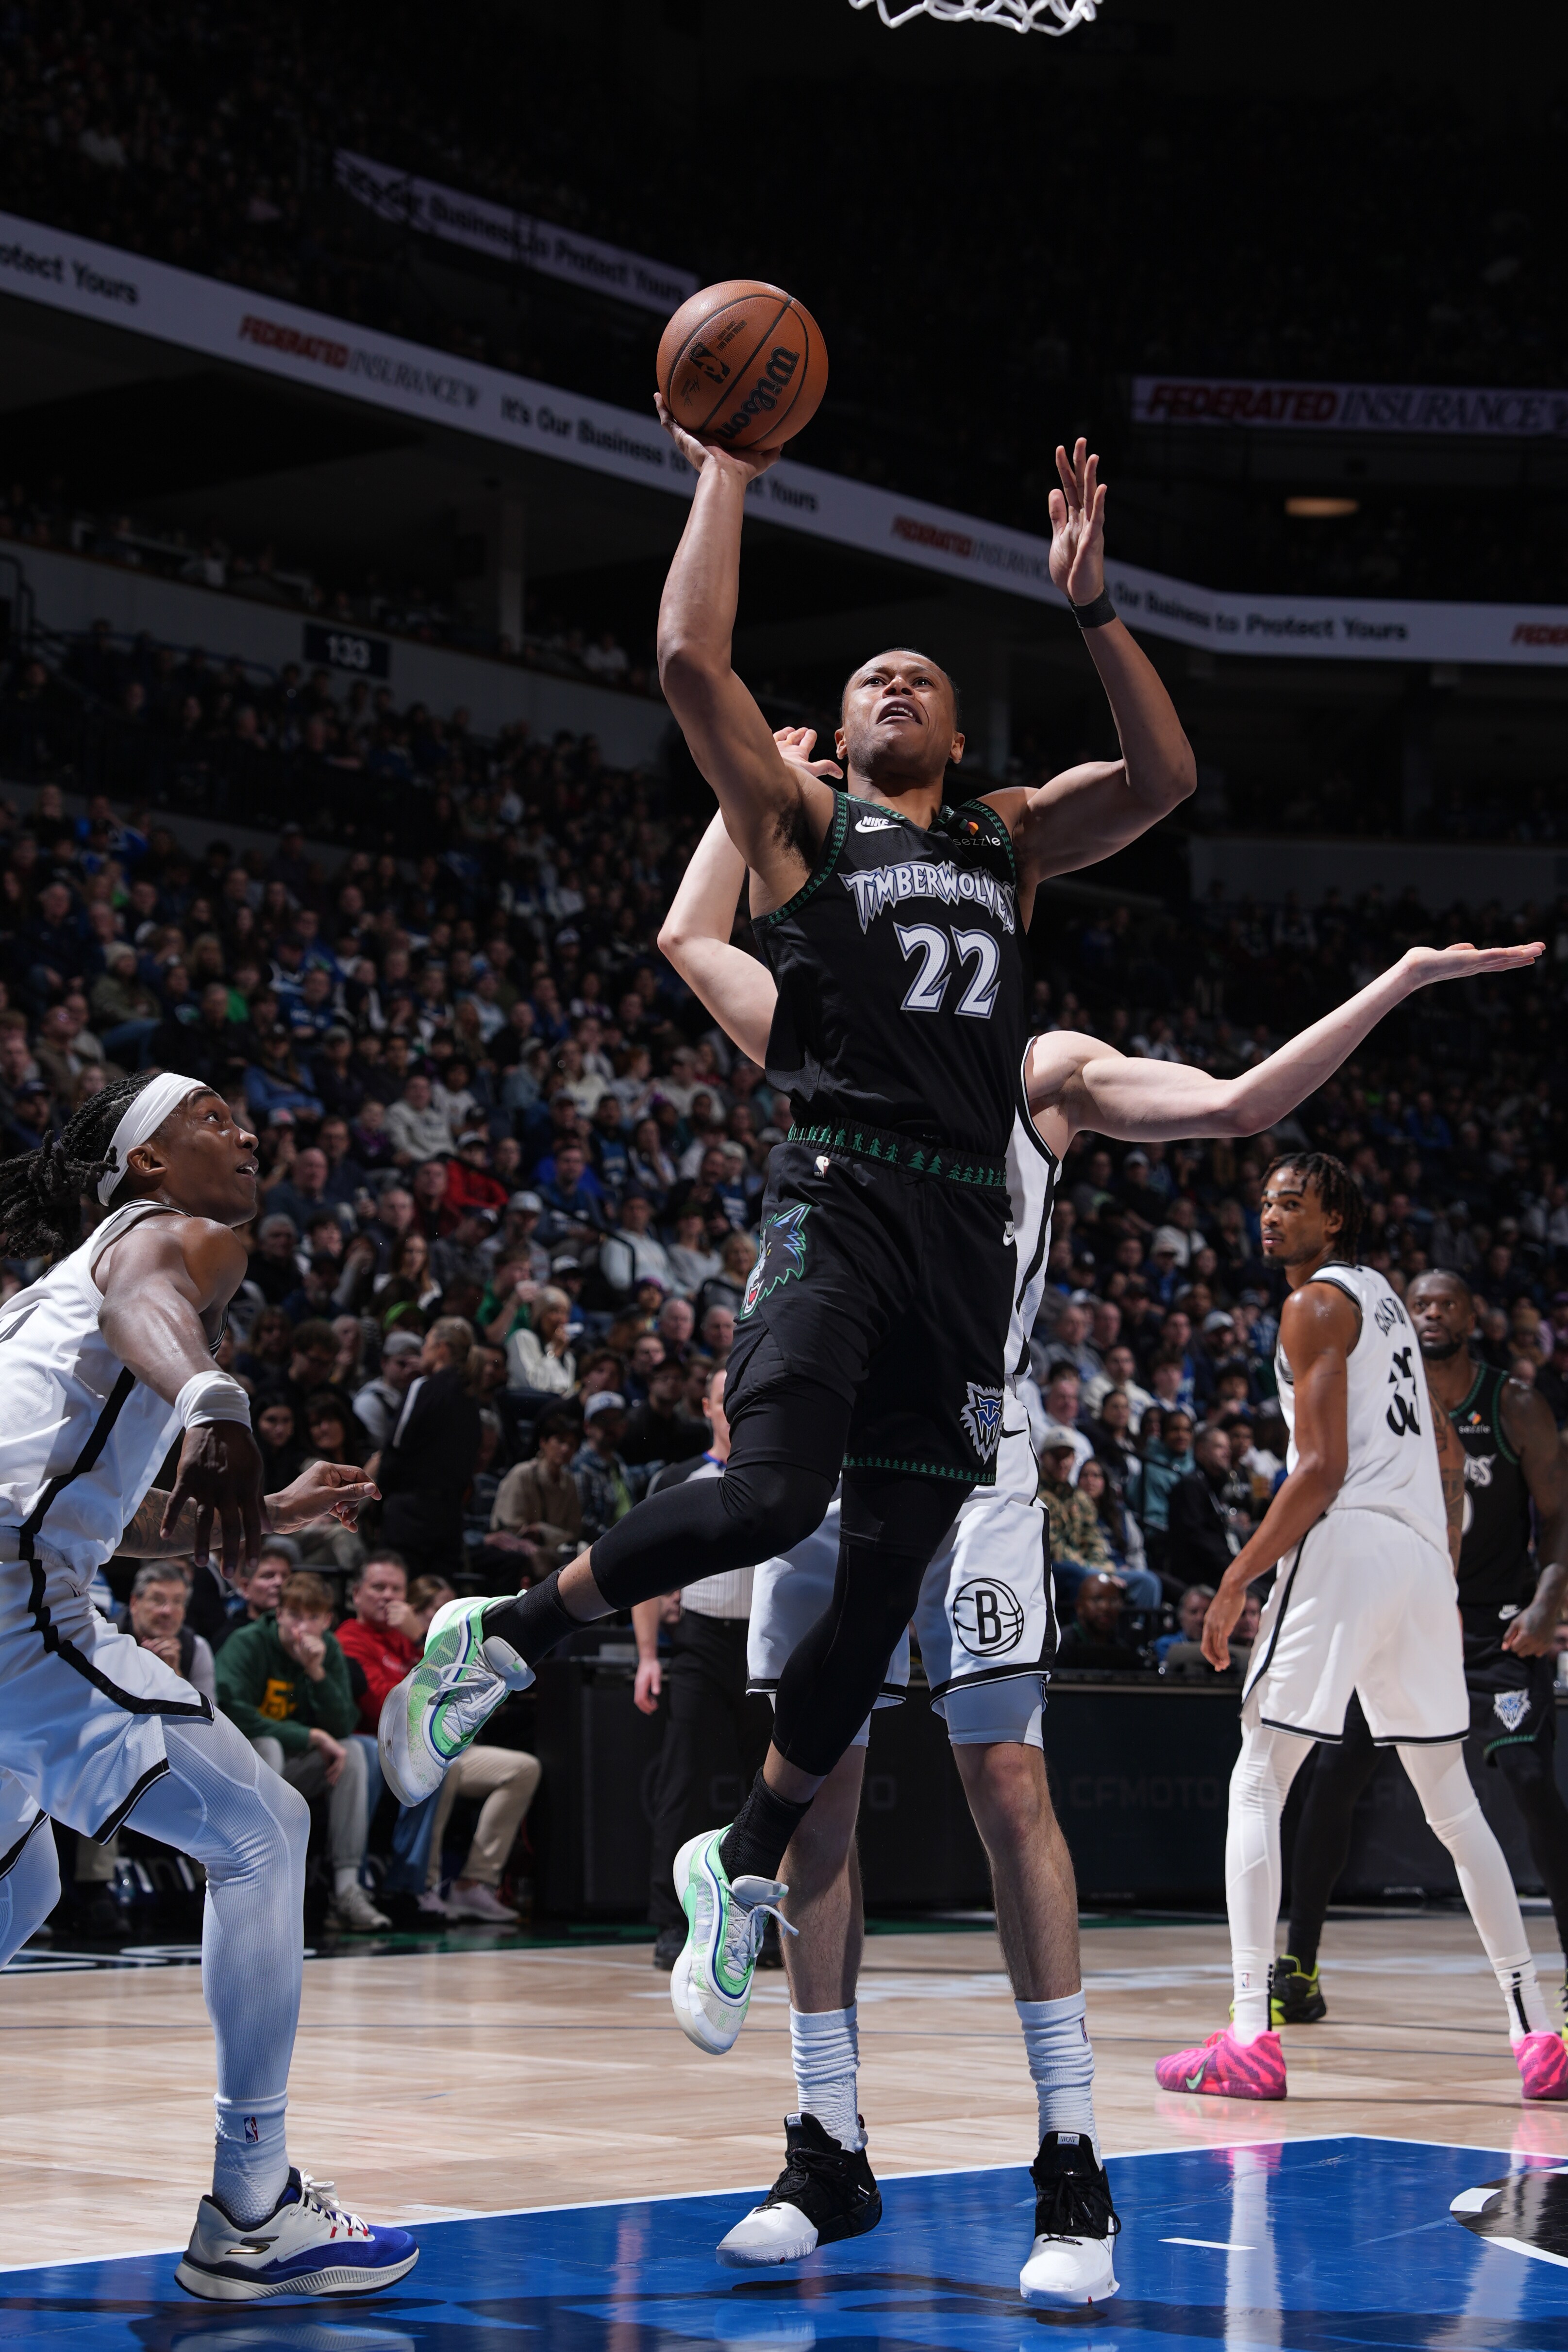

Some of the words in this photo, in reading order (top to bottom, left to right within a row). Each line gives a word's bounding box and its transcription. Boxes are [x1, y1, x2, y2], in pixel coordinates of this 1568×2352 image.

[72, 259, 138, 305] Yours
[239, 315, 349, 371] FEDERATED
[536, 409, 572, 437] Our
[578, 417, 664, 466] Business
[714, 346, 800, 439] Wilson
[1147, 384, 1338, 422] FEDERATED
[1340, 389, 1549, 429] INSURANCE
[1216, 612, 1239, 634] to
[1246, 612, 1334, 638] Protect
[1344, 618, 1408, 641] Yours
[862, 816, 889, 827] NIKE
[953, 835, 1001, 847] sezzle
[837, 860, 1017, 935] TIMBERWOLVES
[892, 921, 1001, 1019] 22
[975, 1590, 1001, 1645] B
[1069, 1774, 1221, 1810] CFMOTO
